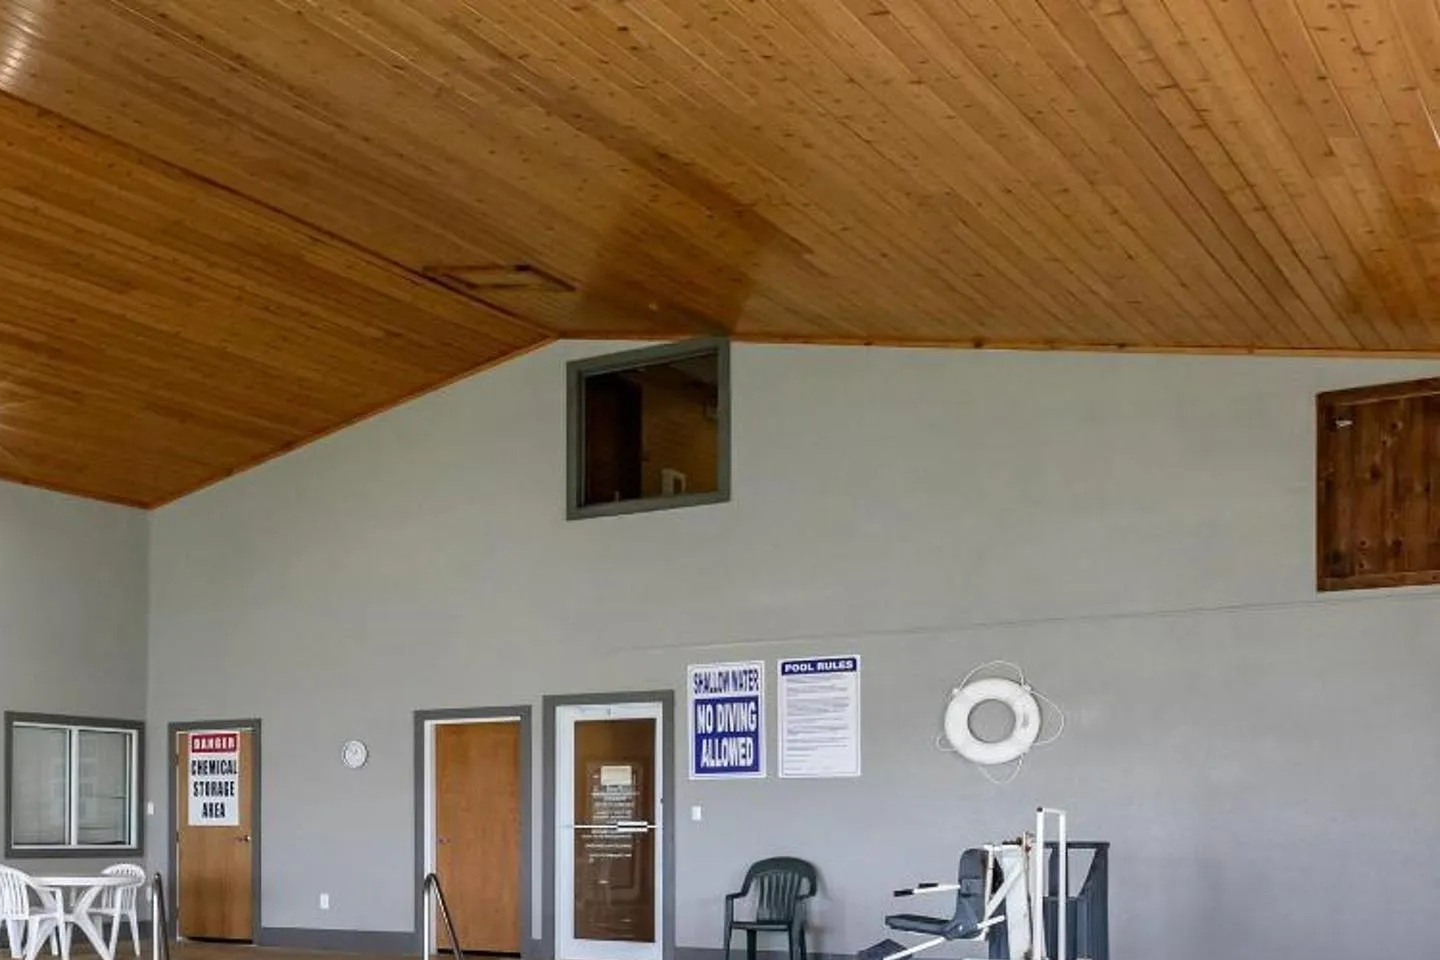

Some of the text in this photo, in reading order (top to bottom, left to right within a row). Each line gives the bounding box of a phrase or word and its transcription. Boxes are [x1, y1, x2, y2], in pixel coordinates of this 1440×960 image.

[784, 660, 854, 673] POOL RULES
[693, 668, 759, 695] SHALLOW WATER
[697, 701, 757, 734] NO DIVING
[193, 737, 235, 750] DANGER
[700, 737, 754, 768] ALLOWED
[191, 760, 237, 776] CHEMICAL
[193, 781, 235, 797] STORAGE
[202, 802, 225, 818] AREA
